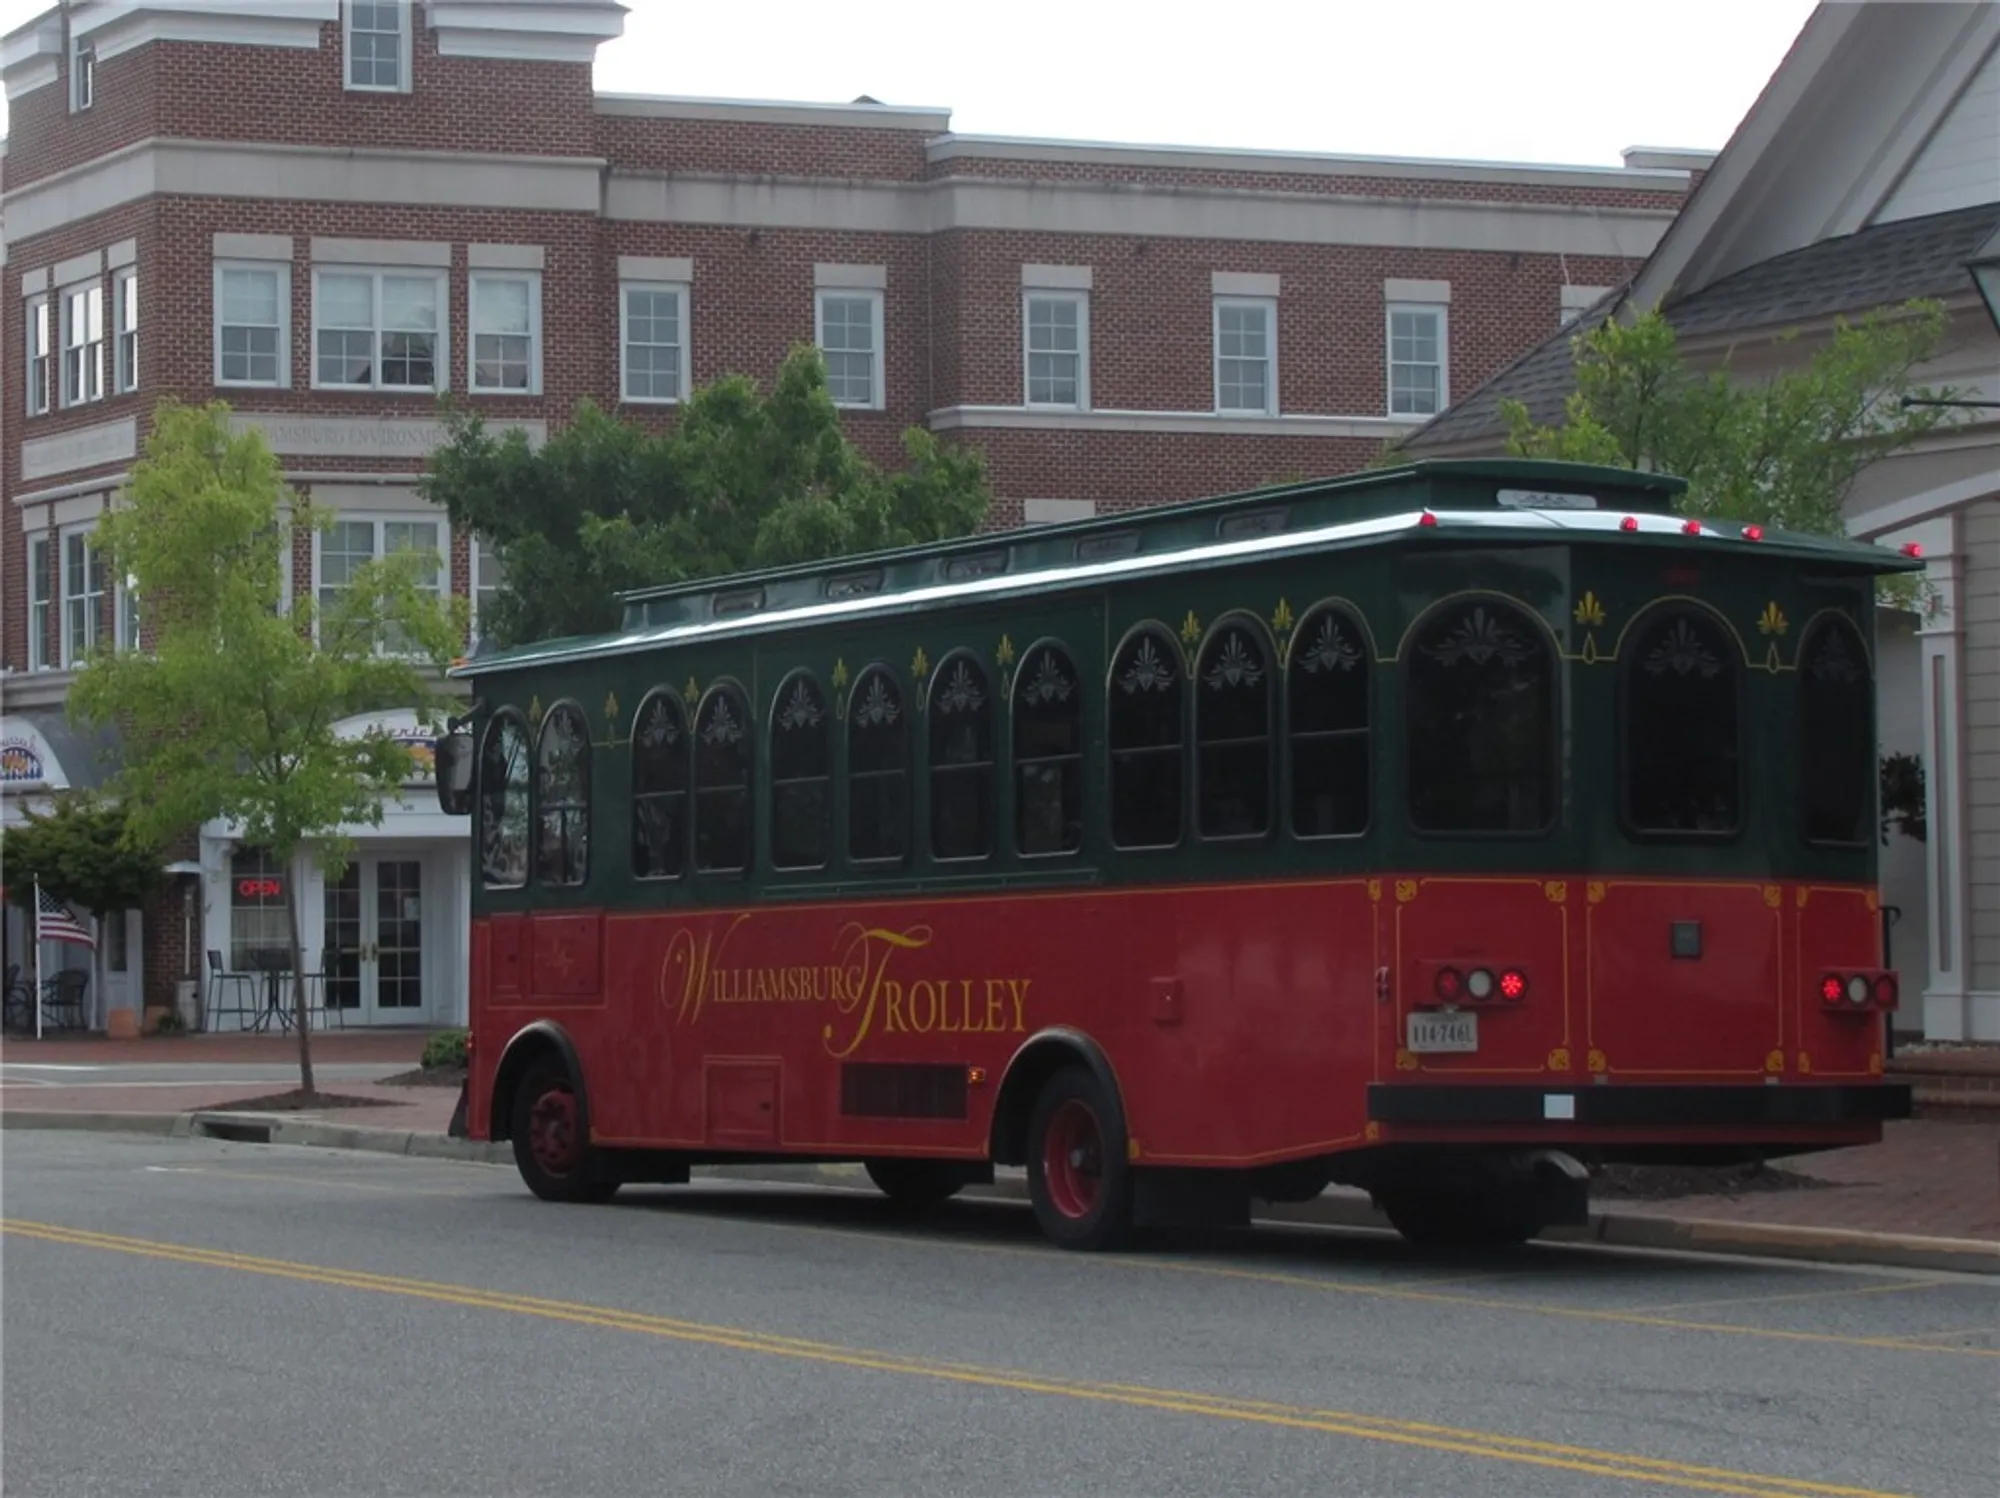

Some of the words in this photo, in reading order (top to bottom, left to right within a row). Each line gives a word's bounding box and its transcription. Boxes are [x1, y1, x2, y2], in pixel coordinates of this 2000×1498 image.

[239, 880, 281, 897] OPEN
[661, 913, 868, 1026] WILLIAMSBURG
[823, 922, 1033, 1058] TROLLEY
